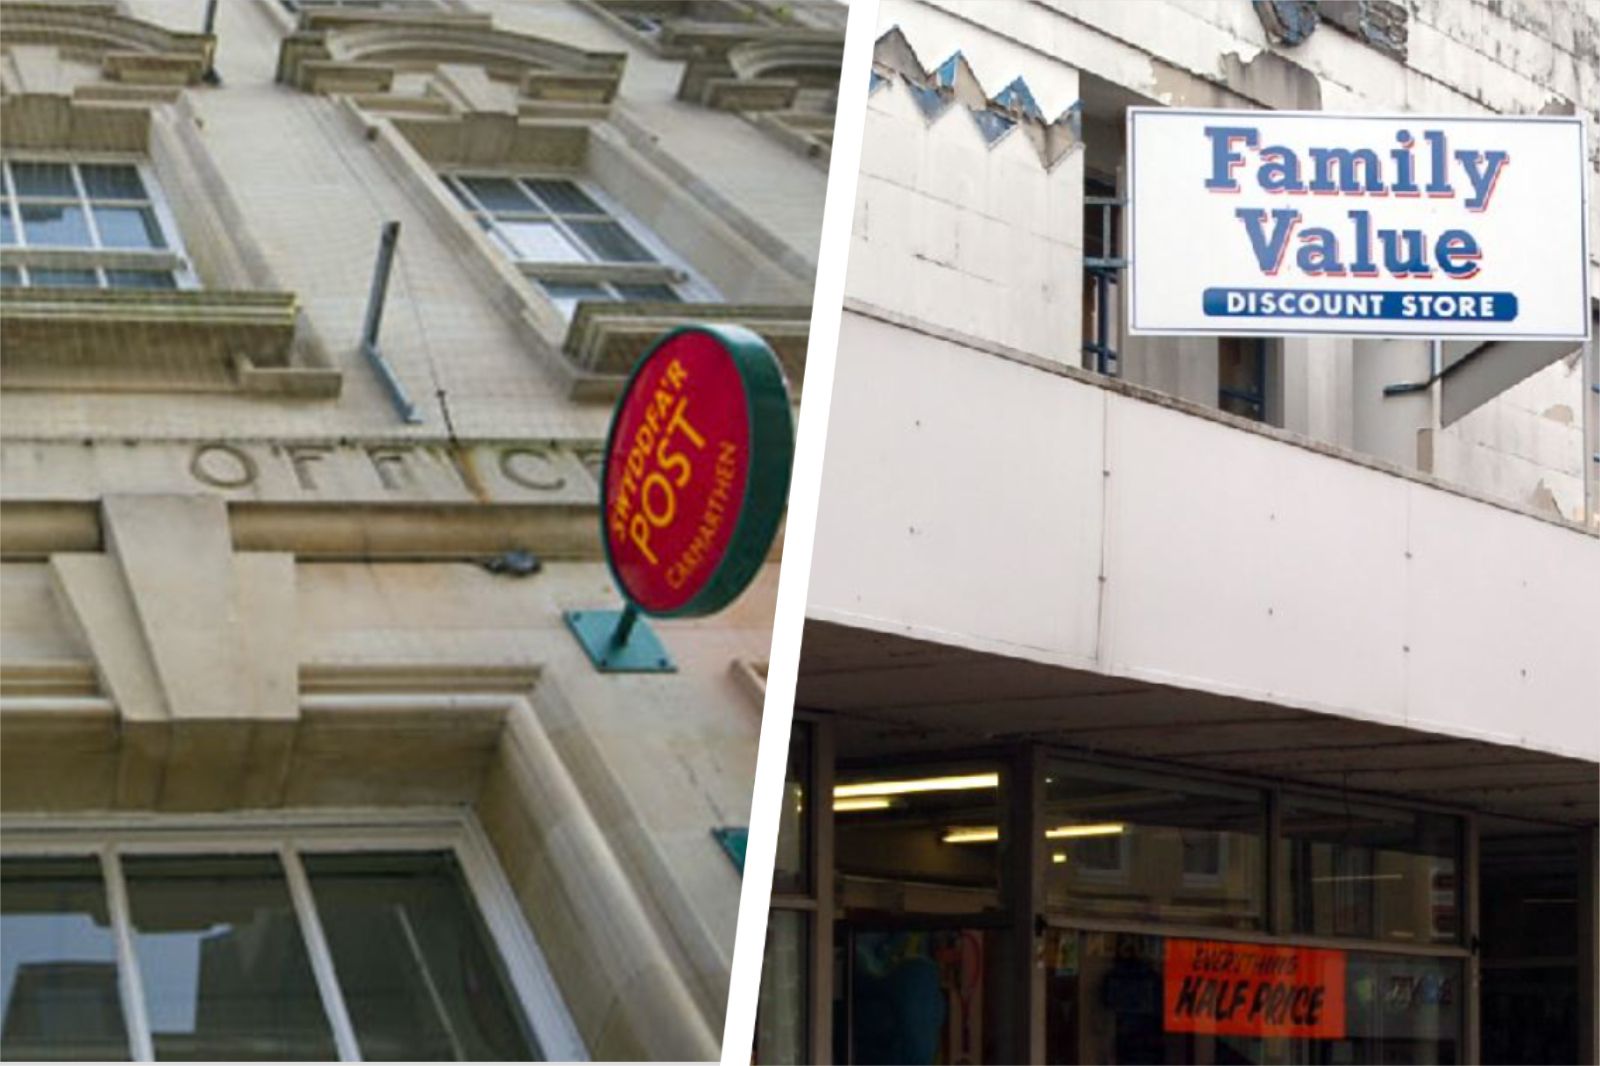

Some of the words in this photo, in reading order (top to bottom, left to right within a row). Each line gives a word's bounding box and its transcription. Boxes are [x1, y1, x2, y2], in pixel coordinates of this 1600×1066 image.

[1204, 126, 1510, 212] Family
[1235, 208, 1482, 279] Value
[1226, 292, 1384, 317] DISCOUNT
[1401, 295, 1495, 318] STORE
[612, 359, 687, 541] SWYDDFA'R
[630, 398, 706, 565] POST
[664, 440, 737, 589] CARMARTHEN
[1174, 975, 1249, 1021] HALF
[1248, 981, 1325, 1026] PRICE
